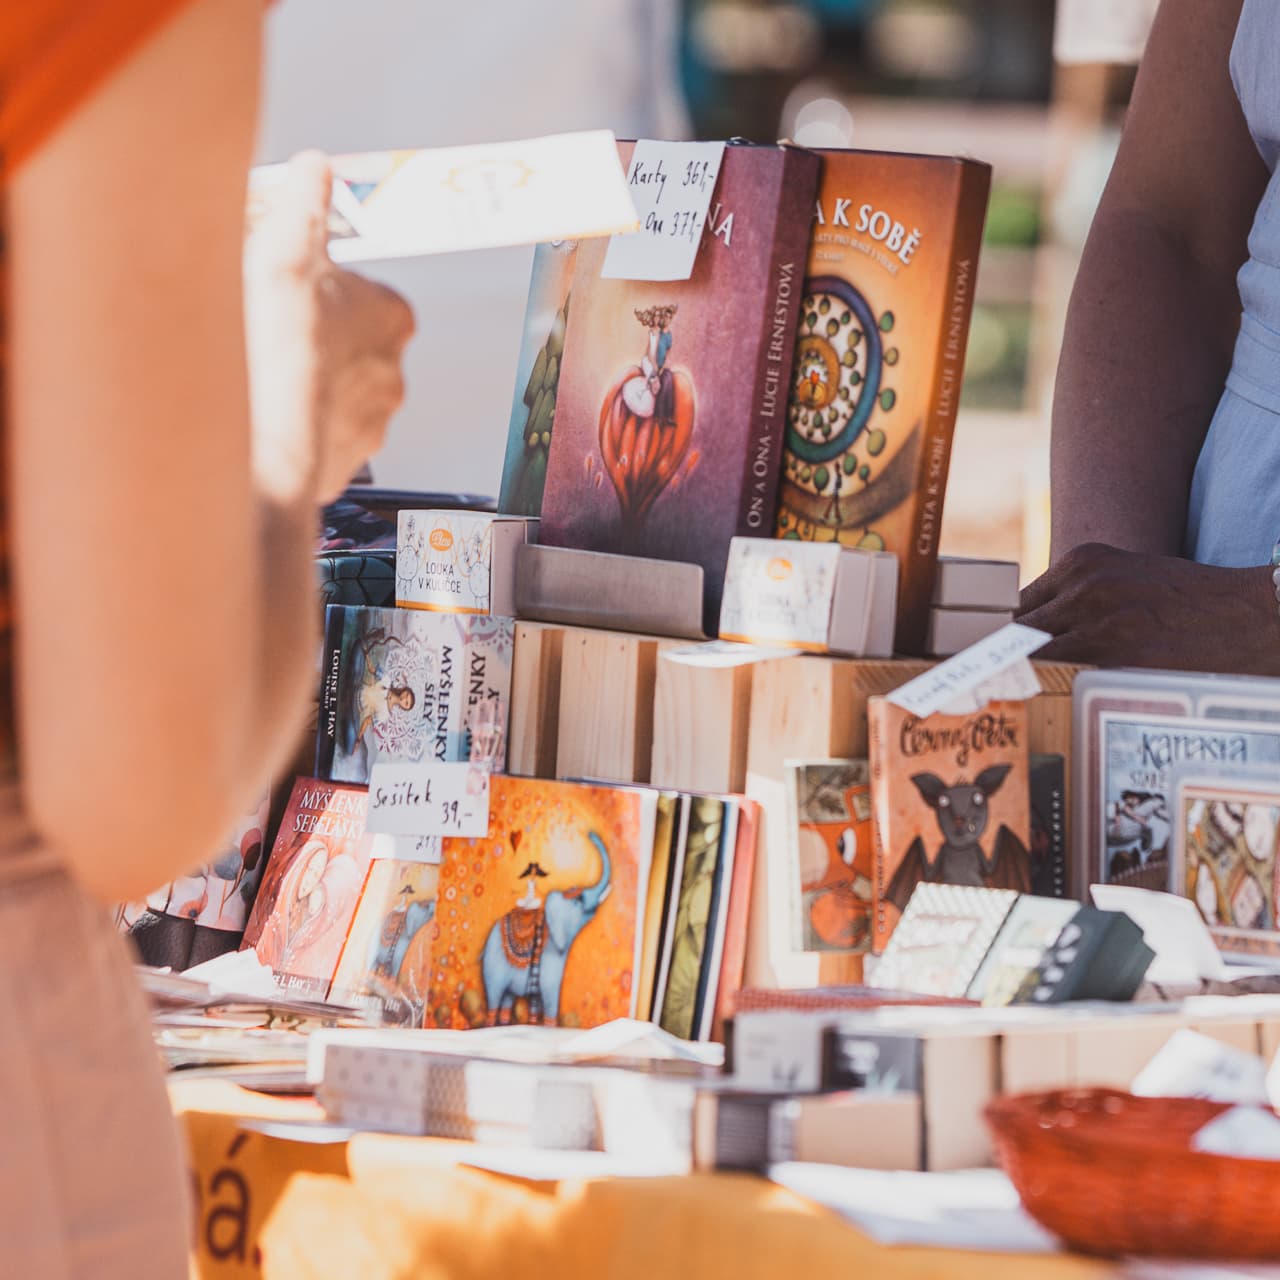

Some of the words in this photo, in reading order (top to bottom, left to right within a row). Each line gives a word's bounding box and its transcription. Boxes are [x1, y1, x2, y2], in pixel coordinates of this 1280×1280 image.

[630, 159, 668, 205] Karty
[832, 197, 852, 229] K
[854, 203, 923, 265] SOBĚ
[330, 649, 341, 694] LOUISE
[422, 681, 436, 722] SÍLY
[434, 645, 453, 762] MYŠLENKY
[327, 711, 337, 737] HAY
[300, 788, 369, 818] MYŠLENK
[441, 801, 473, 829] 39,-
